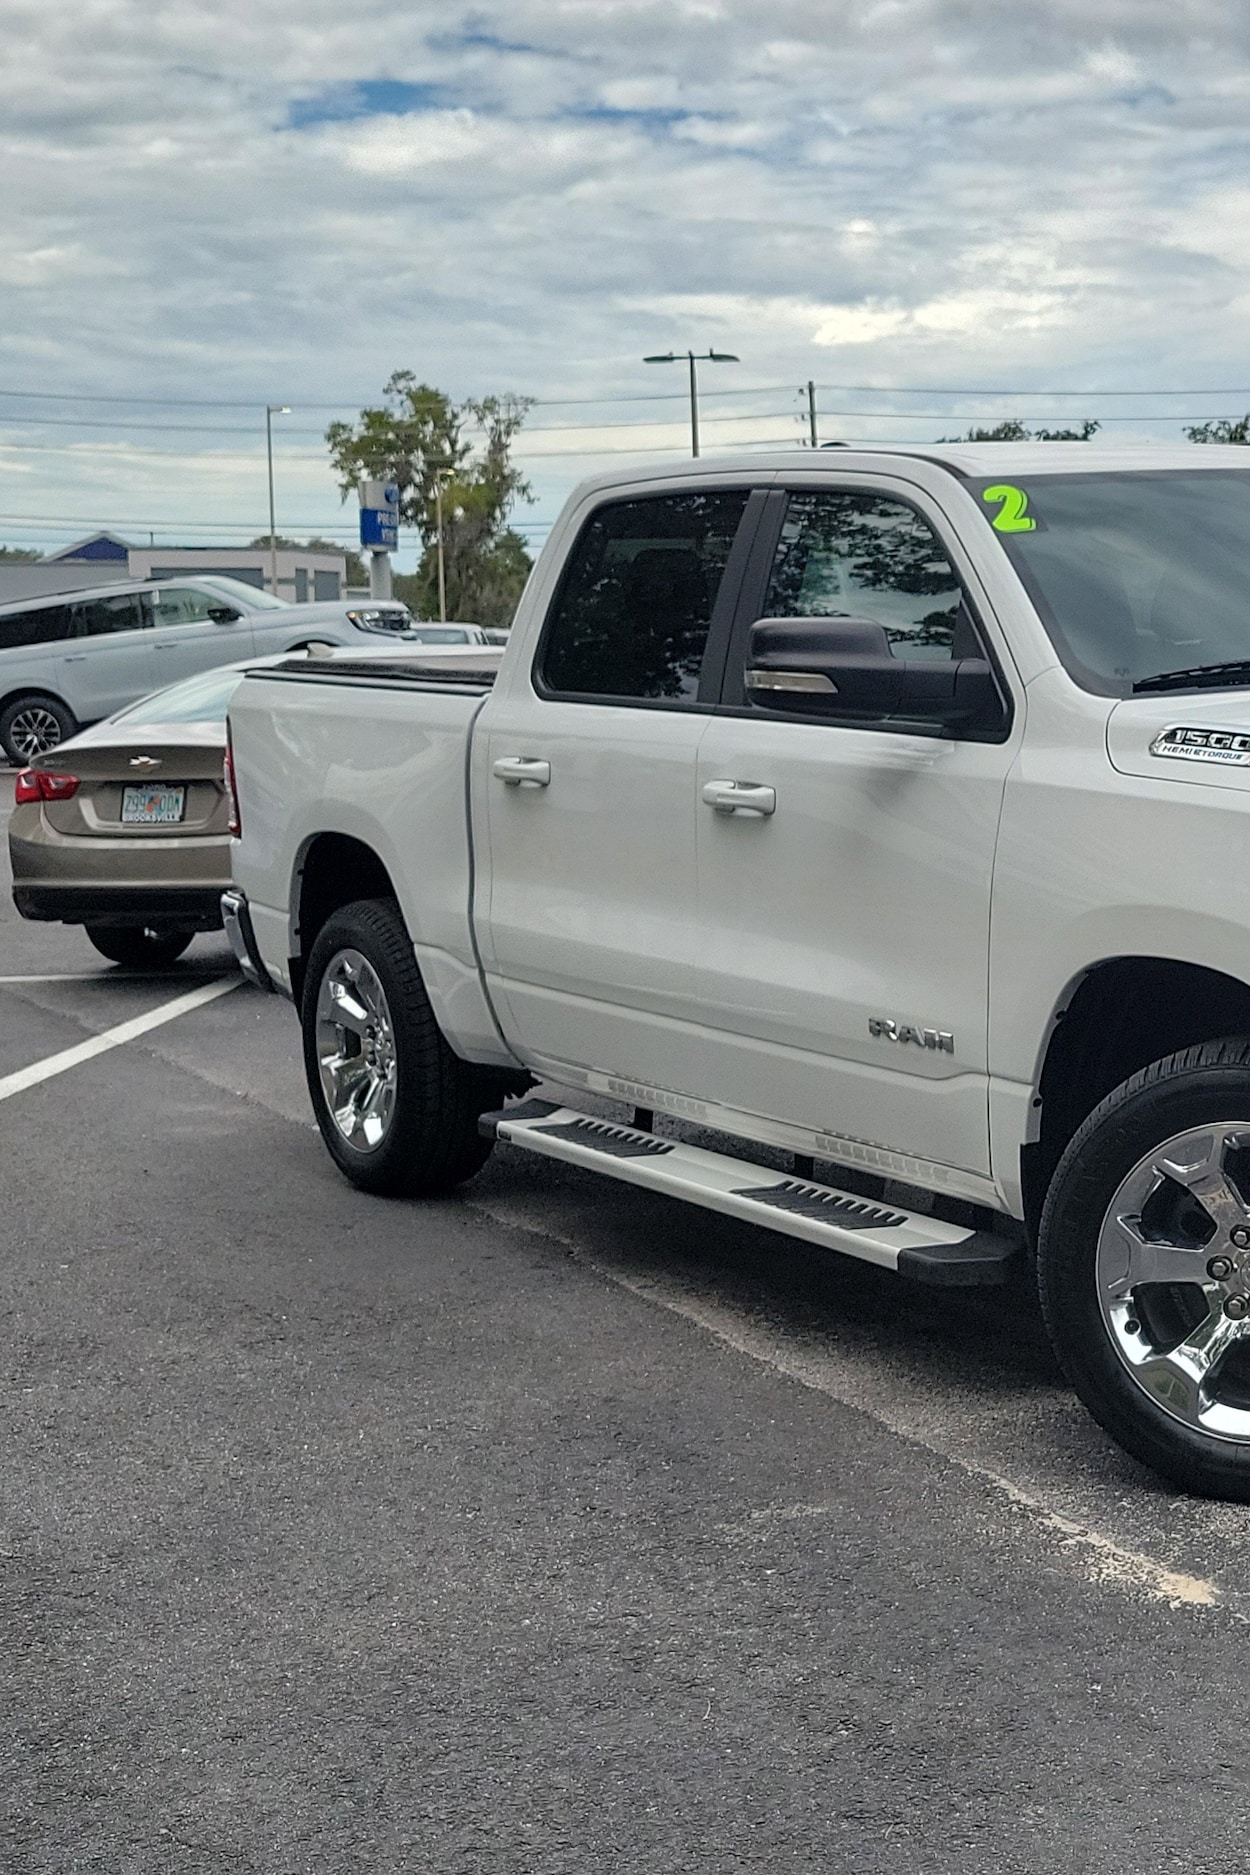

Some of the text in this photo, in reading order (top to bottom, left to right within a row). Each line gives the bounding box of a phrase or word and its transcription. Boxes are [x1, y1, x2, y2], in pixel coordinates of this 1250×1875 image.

[983, 485, 1036, 533] 2
[1162, 745, 1192, 755] HEMI
[868, 1018, 955, 1055] RAM
